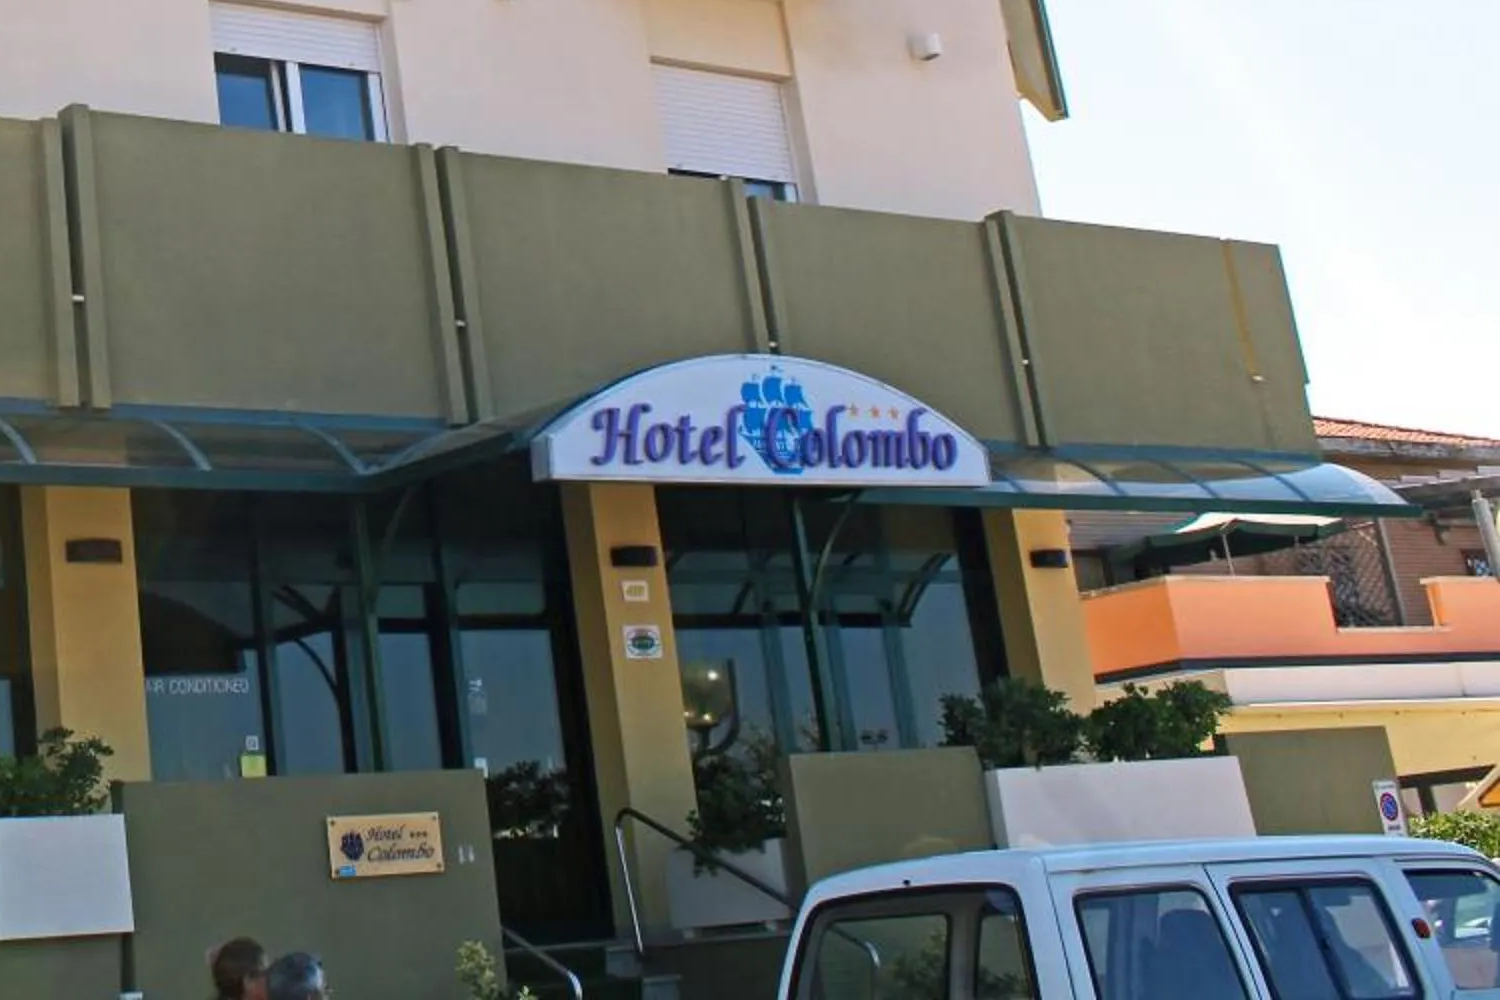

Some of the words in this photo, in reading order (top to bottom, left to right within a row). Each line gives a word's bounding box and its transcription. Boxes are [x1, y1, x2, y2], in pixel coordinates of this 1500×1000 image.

[589, 402, 746, 469] Hotel
[765, 403, 959, 471] Colombo
[364, 823, 405, 842] Hotel
[367, 842, 435, 863] Colombo
